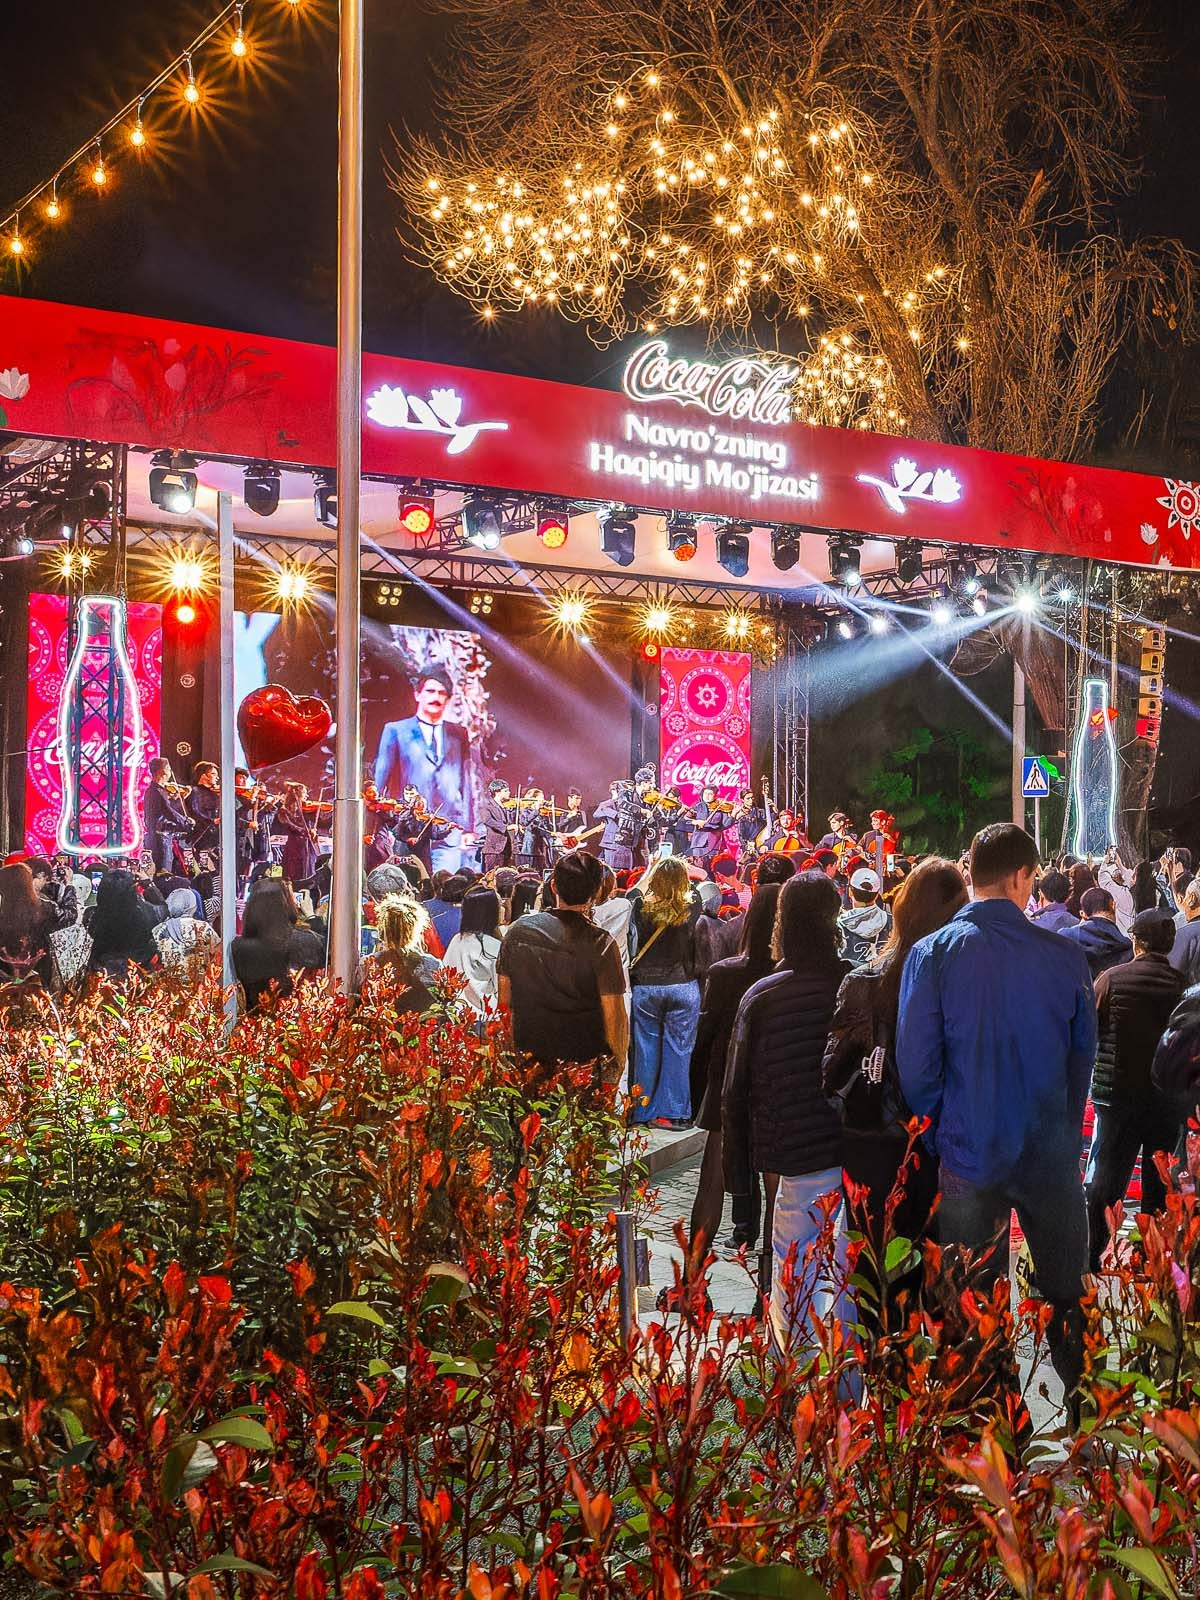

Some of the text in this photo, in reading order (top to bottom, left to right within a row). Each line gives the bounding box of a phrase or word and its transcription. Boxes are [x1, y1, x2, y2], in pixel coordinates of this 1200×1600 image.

[625, 413, 787, 468] Navro'zning
[589, 442, 820, 500] Haqiqiy Mo'jizasi
